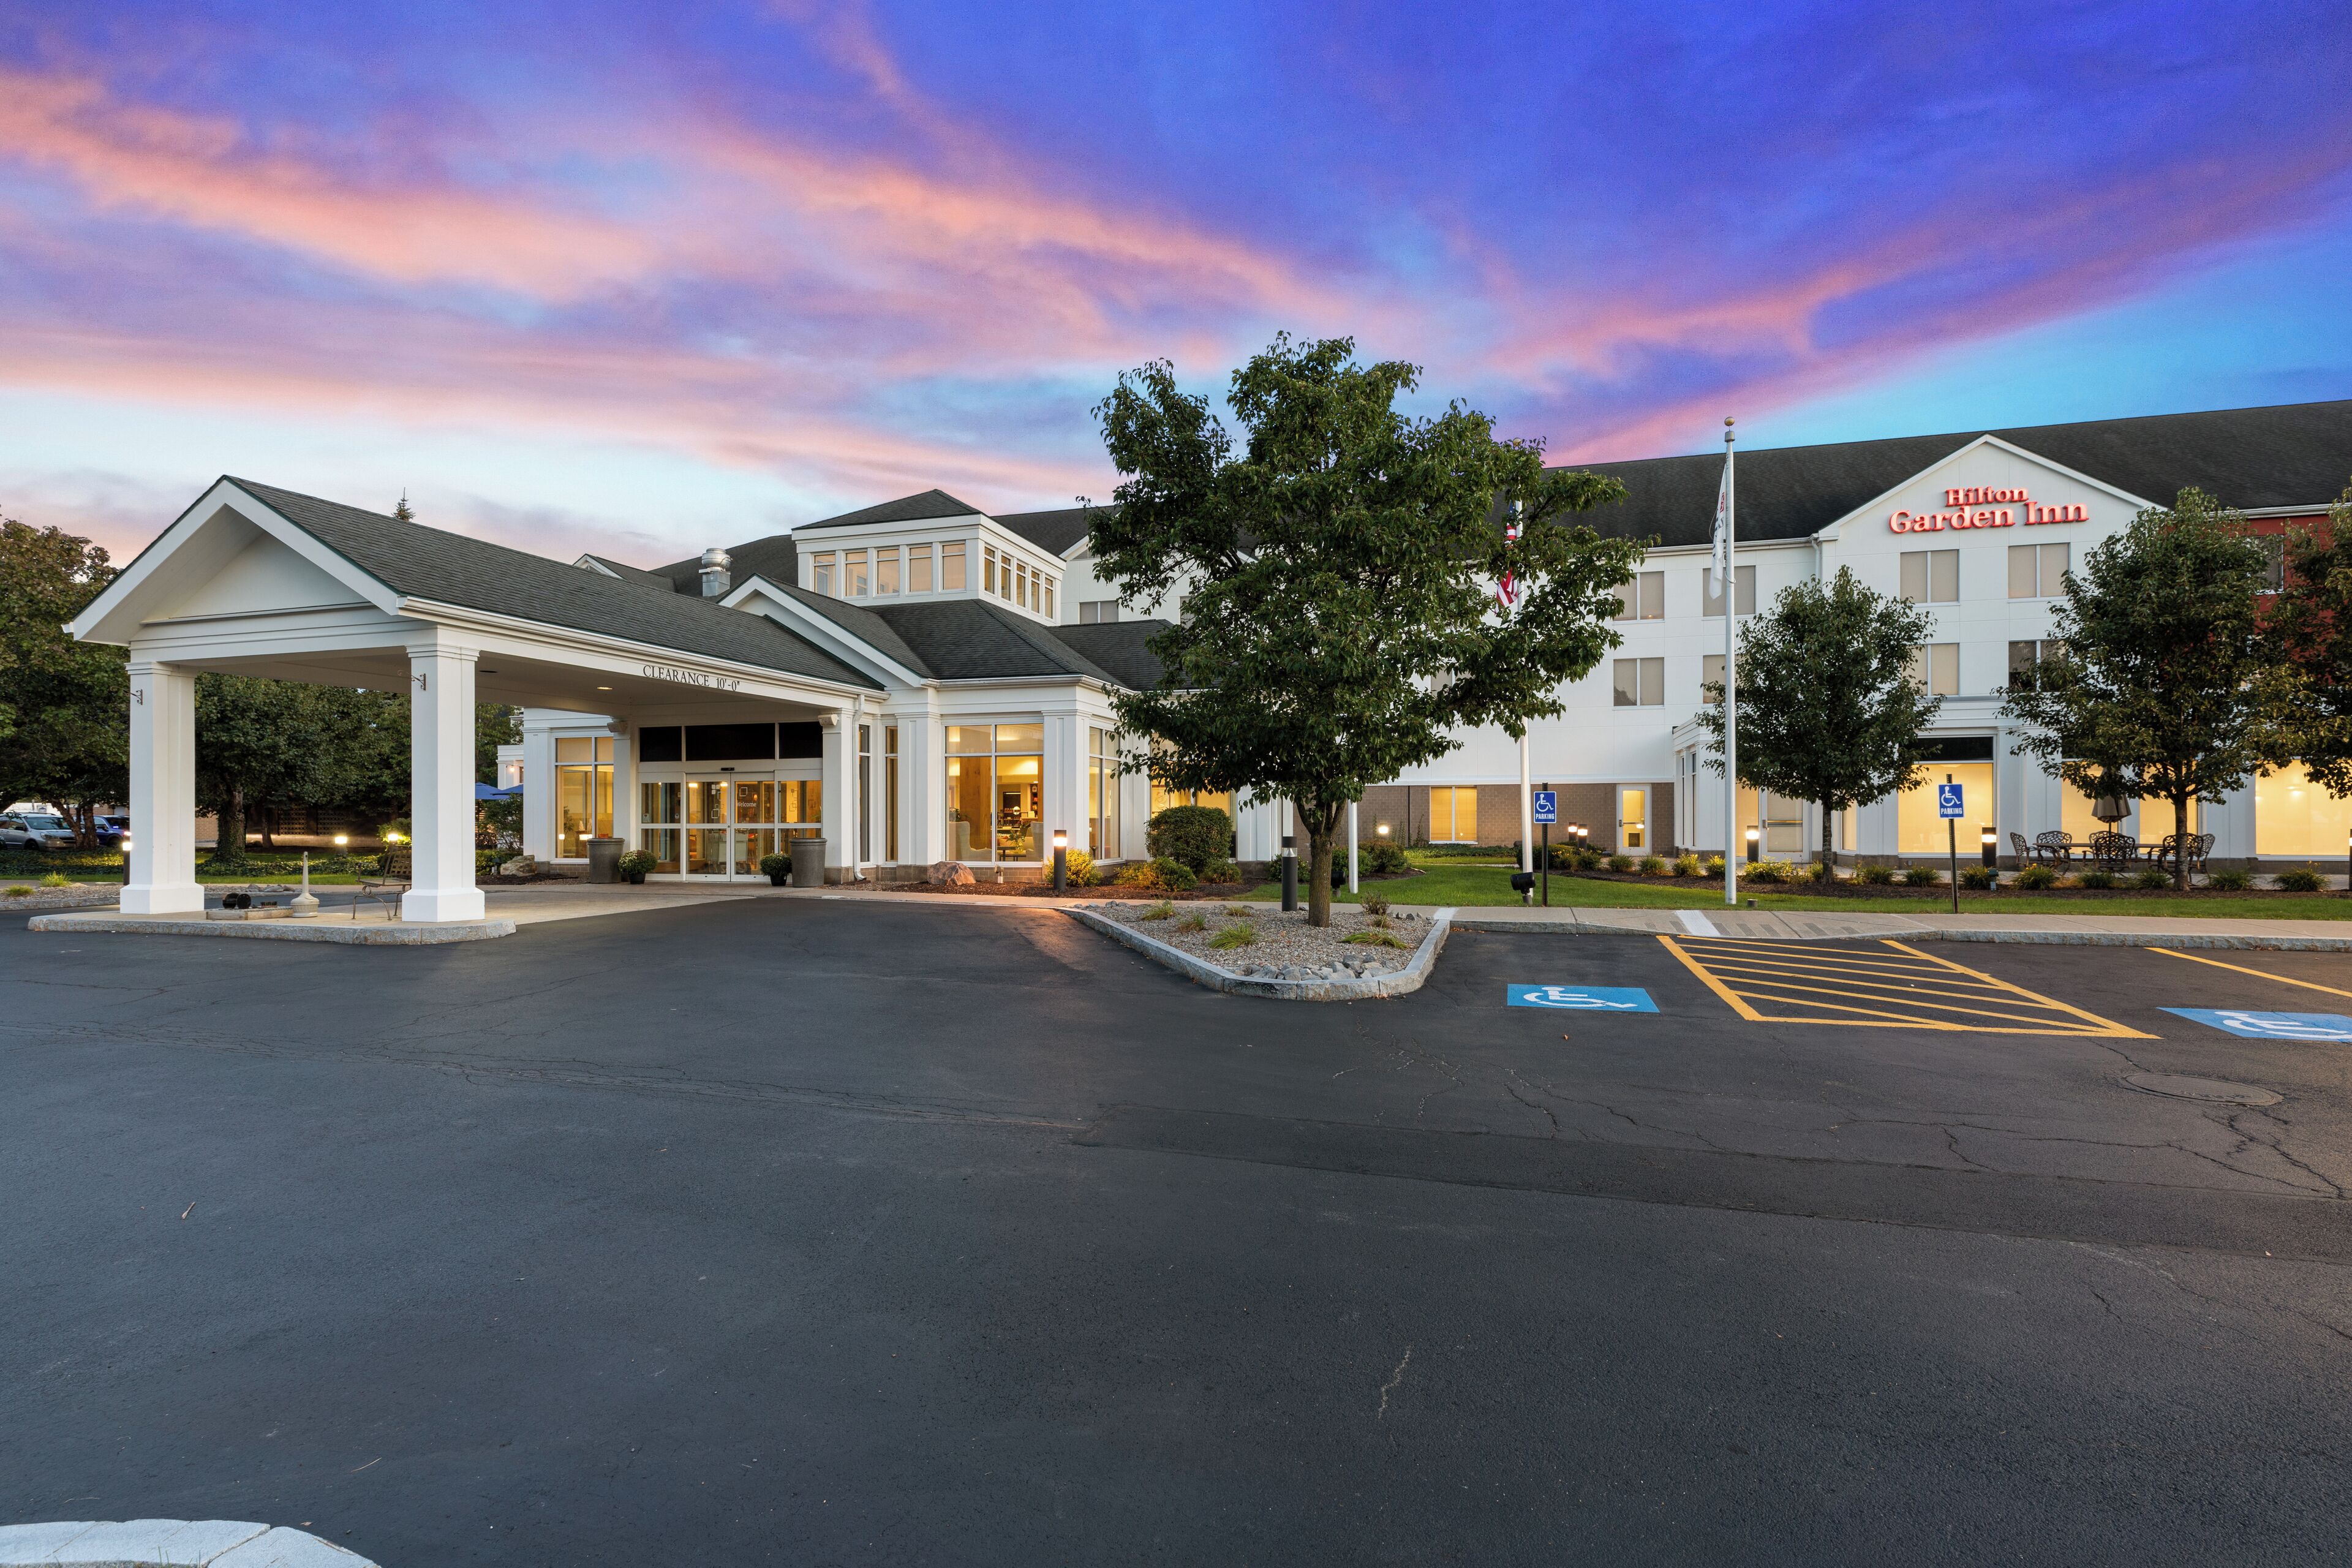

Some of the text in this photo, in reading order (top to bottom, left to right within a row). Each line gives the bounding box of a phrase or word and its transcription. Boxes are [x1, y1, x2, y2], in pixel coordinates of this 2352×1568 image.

[1945, 486, 2029, 507] Hilton
[1890, 501, 2089, 533] Garden Inn
[643, 665, 710, 687] CLEARANCE
